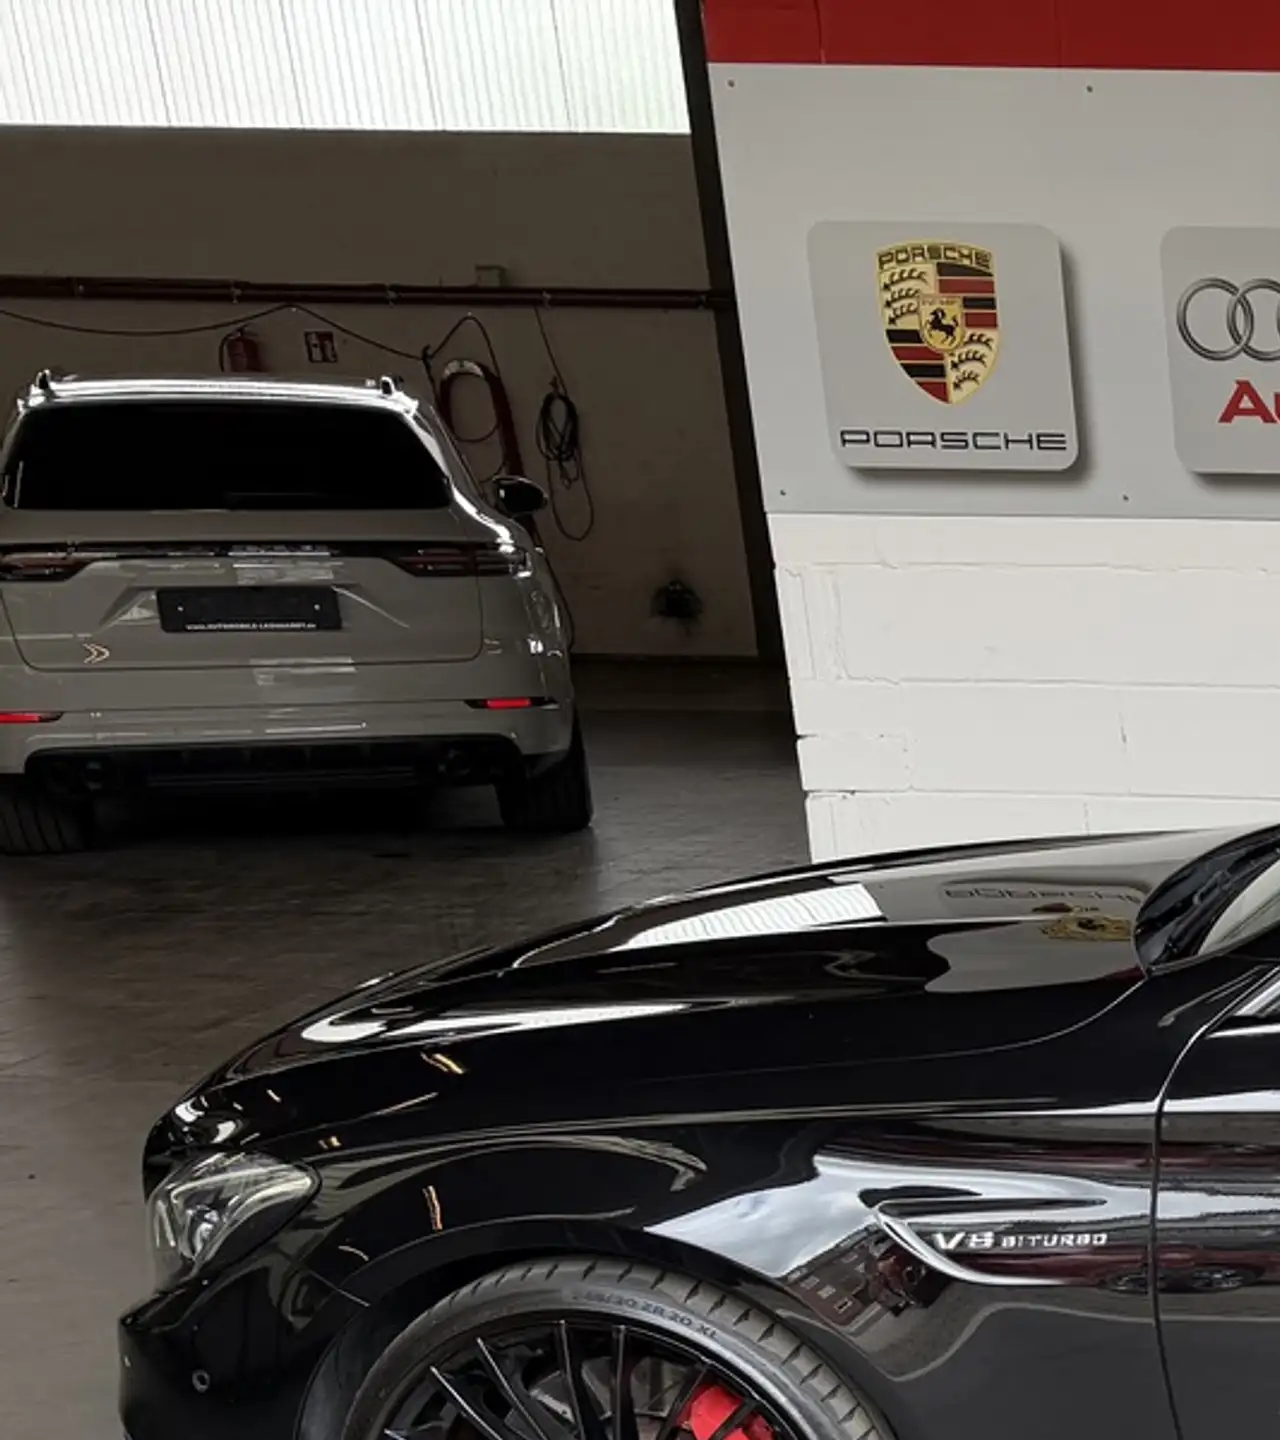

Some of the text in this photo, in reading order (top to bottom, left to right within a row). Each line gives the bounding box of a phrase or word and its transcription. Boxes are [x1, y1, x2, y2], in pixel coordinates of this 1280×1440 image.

[878, 245, 992, 270] PORSCHE
[839, 429, 1067, 451] PORSCHE
[931, 1230, 1108, 1251] V8 BITURBO
